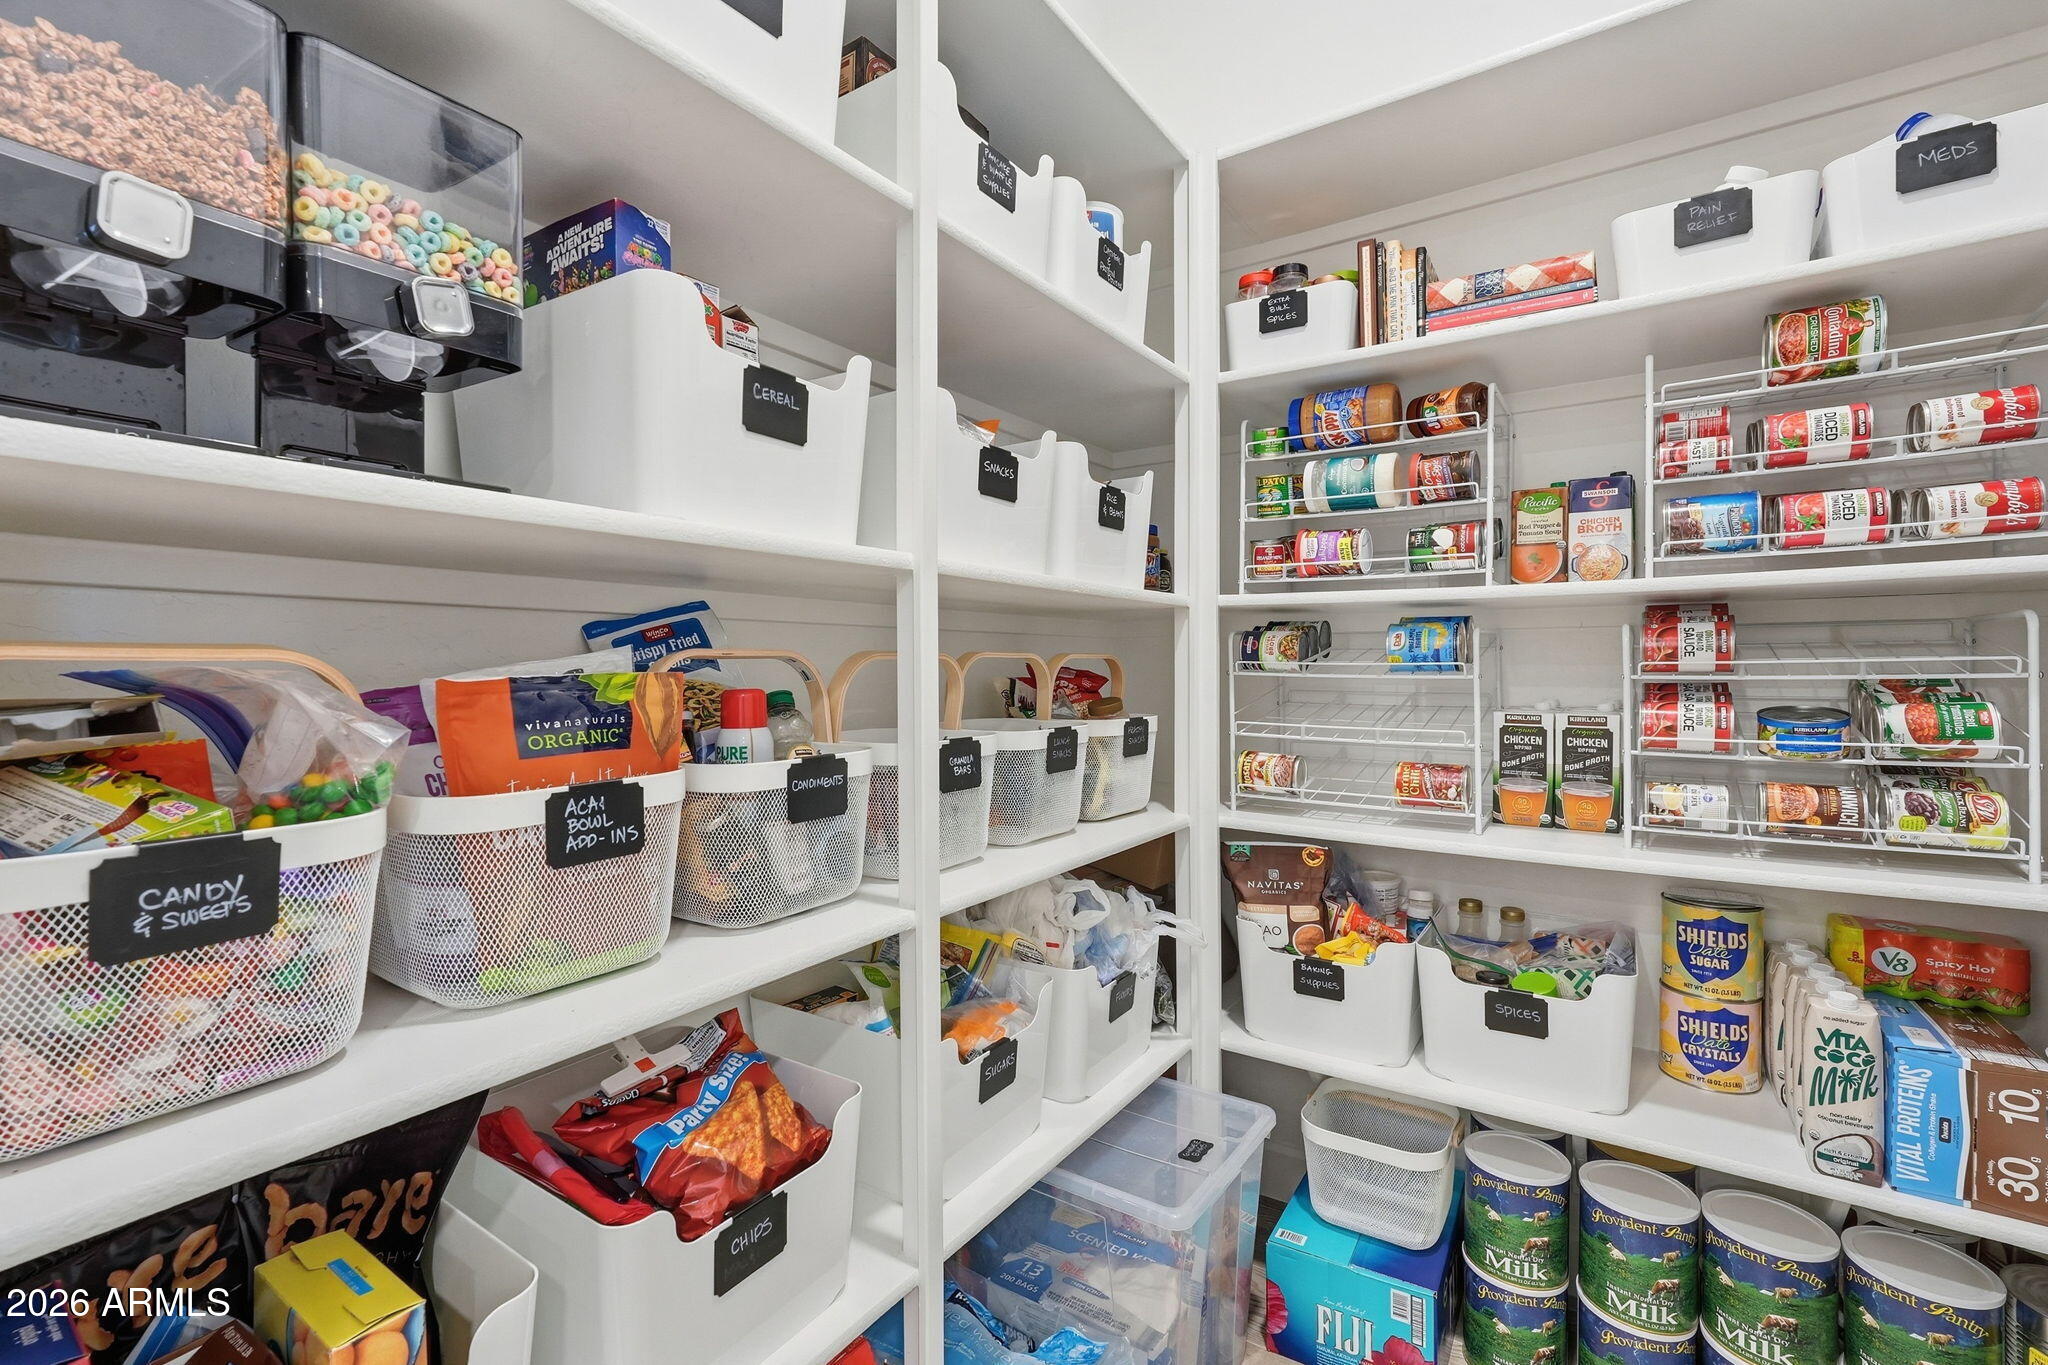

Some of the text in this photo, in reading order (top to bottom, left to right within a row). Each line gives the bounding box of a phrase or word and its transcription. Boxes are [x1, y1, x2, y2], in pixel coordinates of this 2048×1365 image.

[1918, 140, 1978, 168] MEDS
[1689, 201, 1722, 219] PAIN
[564, 222, 582, 241] NEW
[1687, 212, 1737, 233] RELIEF
[546, 217, 612, 263] ADVENTURE
[551, 234, 604, 275] AWAITS!
[1266, 312, 1298, 324] SPICES
[1270, 304, 1290, 313] BULK
[1810, 316, 1818, 352] CRUSHED
[1824, 306, 1843, 358] Contadina
[752, 382, 800, 410] CEREAL
[1814, 414, 1824, 442] TOMATOES
[1824, 412, 1838, 440] DICED
[984, 461, 1014, 478] SNACKS
[1106, 492, 1118, 504] RICE
[1523, 496, 1558, 506] Pacific
[1831, 494, 1841, 520] TOMATOES
[1842, 493, 1856, 520] DICED
[1578, 523, 1622, 534] BROTH
[1580, 516, 1620, 525] CHICKEN
[646, 628, 668, 638] WinCo
[1684, 628, 1695, 658] SAUCE
[1696, 631, 1704, 652] TOMATO
[1705, 630, 1714, 652] ORGANIC
[632, 642, 667, 662] rispy
[670, 632, 701, 650] Fried
[526, 714, 626, 730] vivanaturals
[1684, 704, 1695, 732] SAUCE
[1963, 709, 1978, 727] Diced
[528, 728, 619, 748] ORGANIC
[1504, 735, 1542, 745] CHICKEN
[1566, 738, 1608, 748] CHICKEN
[716, 746, 748, 761] PURE
[1502, 753, 1544, 768] BONE BROTH
[1564, 756, 1610, 771] BONE BROTH
[953, 764, 972, 776] BARS
[792, 774, 844, 792] CONDIMENTS
[1410, 770, 1420, 795] Chili
[568, 814, 613, 832] BOWL
[1959, 806, 1967, 827] BEANS
[566, 826, 638, 853] ADD-INS
[139, 874, 244, 910] CANDY
[1248, 880, 1300, 890] NAVITAS
[133, 895, 252, 938] & SWEETS
[1678, 926, 1748, 950] SHIELDS
[1688, 940, 1734, 958] Date
[1300, 965, 1333, 976] BAKING
[1690, 955, 1730, 970] SUGAR
[1878, 951, 1908, 972] V8
[1926, 958, 1996, 975] Spicy Hot
[1300, 979, 1340, 992] SUPPLIES
[1494, 1003, 1542, 1022] SPICES
[1680, 1015, 1748, 1042] SHIELDS
[1690, 1034, 1735, 1050] Date
[1816, 1028, 1870, 1053] VITA
[1682, 1043, 1741, 1063] CRYSTALS
[1814, 1045, 1876, 1068] COCO
[709, 1052, 749, 1090] Size!
[985, 1050, 1016, 1082] SUGARS
[667, 1093, 721, 1135] Party
[1818, 1114, 1874, 1130] coconut beverage
[1830, 1112, 1862, 1122] non-dairy
[1896, 1064, 1932, 1182] VITAL PROTEINS
[1928, 1112, 1936, 1130] Protein
[1833, 1157, 1859, 1167] original
[1472, 1172, 1567, 1207] Provident Pantry
[731, 1217, 773, 1256] CHIPS
[1592, 1208, 1697, 1248] Provident Pantry
[1067, 1230, 1128, 1257] SCENTED
[1485, 1241, 1505, 1255] Instant
[1023, 1261, 1045, 1276] 13
[1485, 1247, 1548, 1282] Milk
[1704, 1230, 1827, 1292] Provident Pantry
[1000, 1273, 1039, 1294] 200 BAGS
[1606, 1280, 1631, 1297] Instant
[1661, 1299, 1674, 1308] Dry
[1478, 1285, 1537, 1308] Provident
[1605, 1288, 1678, 1324] Milk
[1846, 1265, 1989, 1339] Provident Pantry
[1316, 1304, 1374, 1362] FIJI
[1716, 1306, 1740, 1324] Instant
[1772, 1336, 1790, 1347] Dry
[1600, 1330, 1670, 1353] Provident
[1715, 1313, 1794, 1365] Milk
